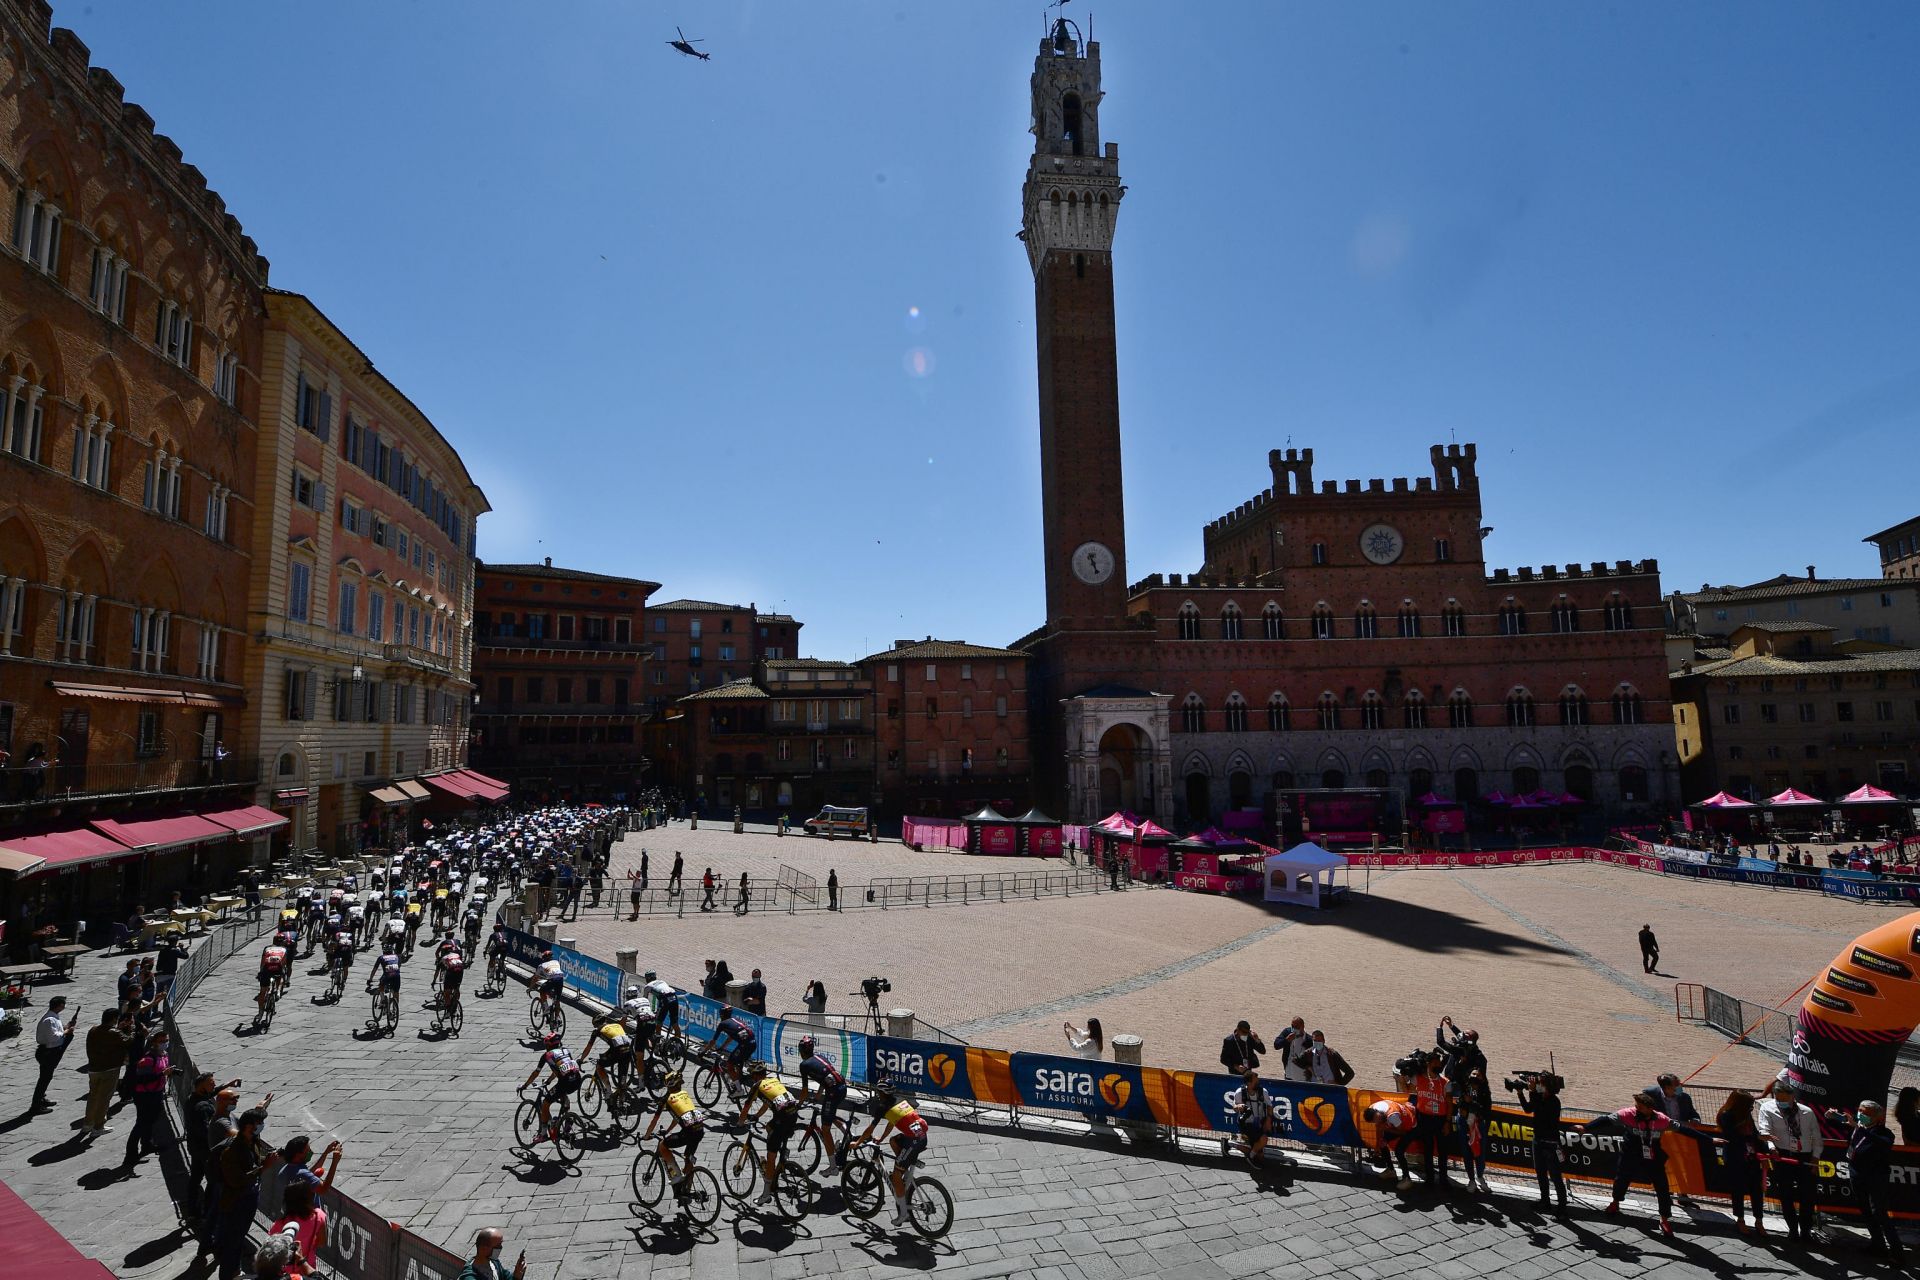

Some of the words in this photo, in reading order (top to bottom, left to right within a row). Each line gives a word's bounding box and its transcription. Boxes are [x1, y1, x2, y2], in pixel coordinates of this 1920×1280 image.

[1640, 857, 1659, 870] enel
[1182, 875, 1208, 888] enel
[1745, 871, 1777, 884] MADE
[1843, 883, 1877, 897] MADE
[875, 1048, 924, 1076] sara
[1035, 1068, 1095, 1096] sara
[1035, 1092, 1044, 1100] TI
[1048, 1093, 1095, 1107] ASSICURA
[1223, 1090, 1292, 1121] sa
[1490, 1142, 1592, 1166] SUPEOD
